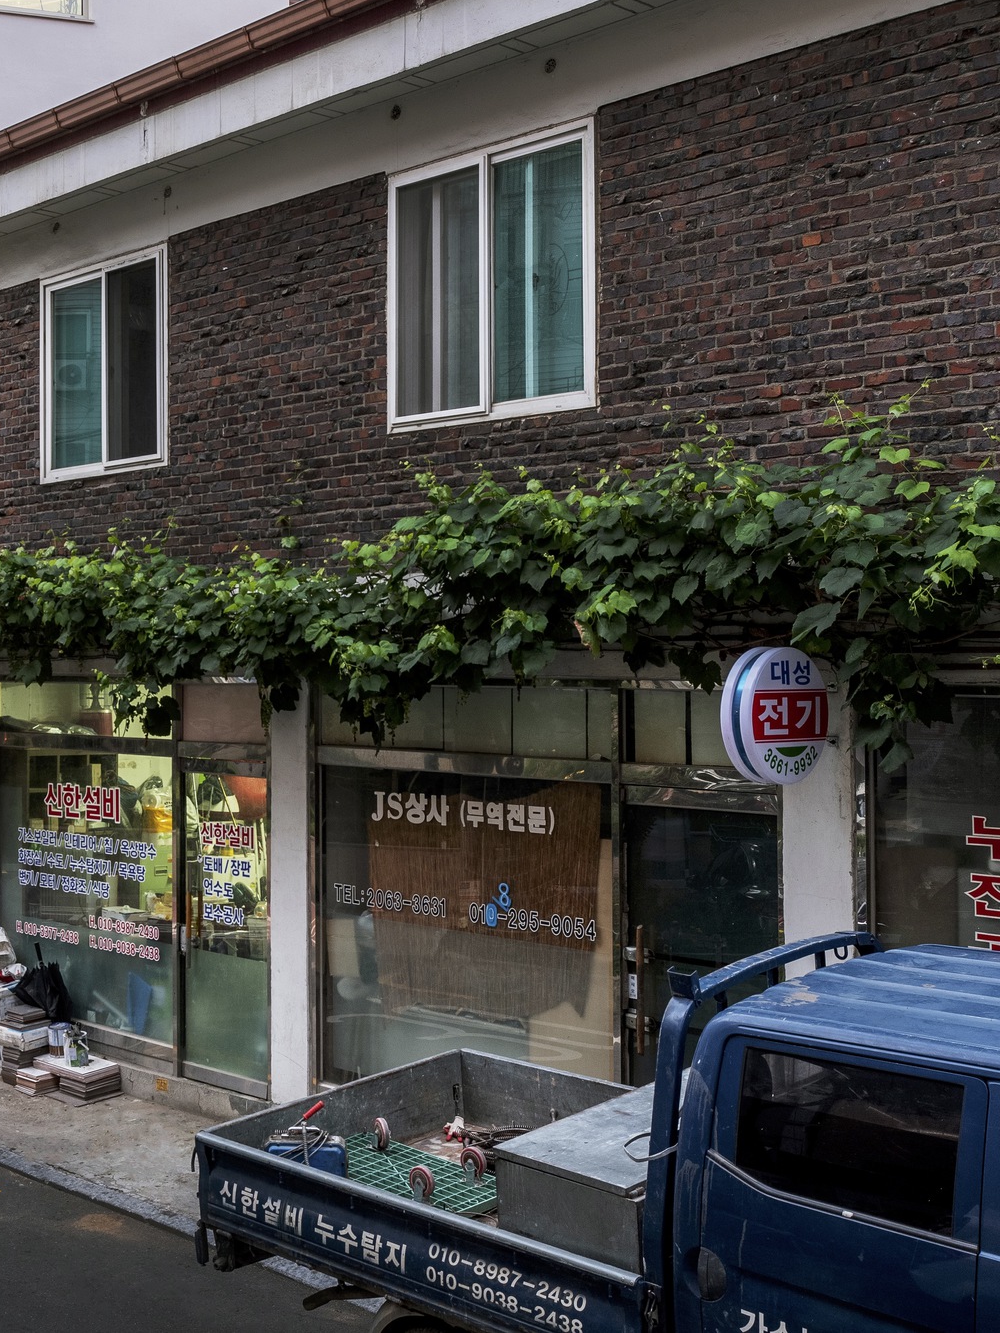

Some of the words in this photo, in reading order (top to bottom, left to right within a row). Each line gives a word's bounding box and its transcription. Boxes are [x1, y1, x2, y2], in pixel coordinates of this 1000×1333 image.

[770, 660, 811, 686] 대성
[758, 696, 821, 737] 전기
[764, 746, 818, 776] 3661-9932
[44, 783, 120, 823] 신한설비
[460, 800, 555, 835] (무역전문)
[121, 839, 157, 860] 옥상방수
[200, 822, 254, 850] 신한설비
[203, 856, 223, 874] 도배
[230, 859, 251, 878] 장판
[98, 916, 159, 941] 010-8987-2430
[203, 903, 244, 926] 보수공사
[98, 936, 160, 961] 010-9038-2438
[219, 1180, 304, 1236] 신한설비
[314, 1213, 407, 1274] 누수탐지
[428, 1242, 587, 1312] 010-8987-2430
[426, 1266, 583, 1333] 010-9038-2438
